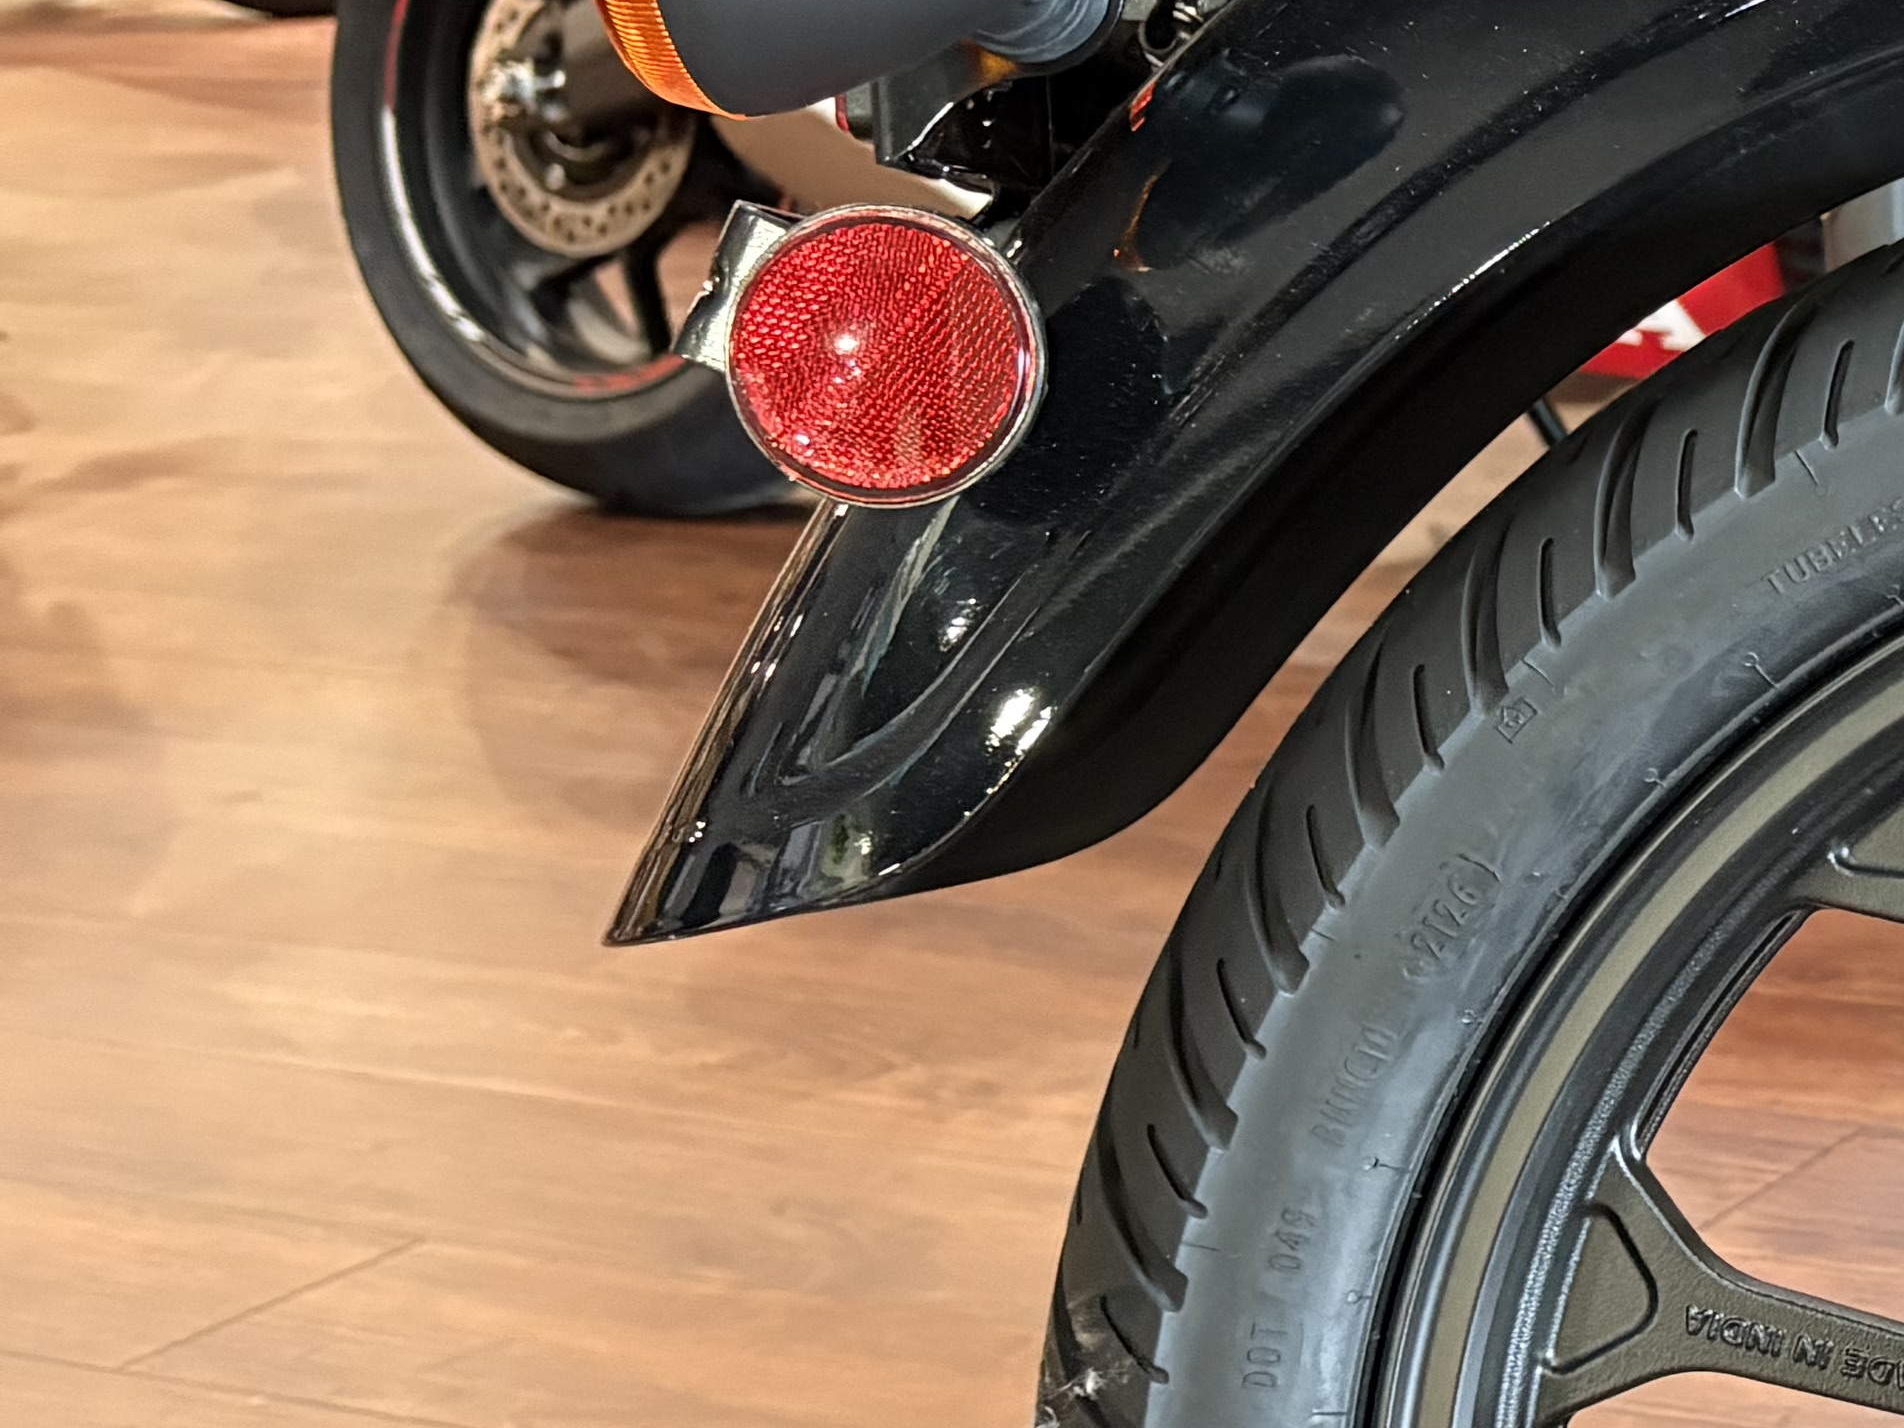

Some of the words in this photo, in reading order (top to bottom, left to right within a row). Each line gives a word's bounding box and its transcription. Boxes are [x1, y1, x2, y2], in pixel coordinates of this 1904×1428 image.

[1241, 1321, 1287, 1390] DOT
[1684, 1303, 1783, 1357] INDIA
[1794, 1331, 1835, 1370] IN
